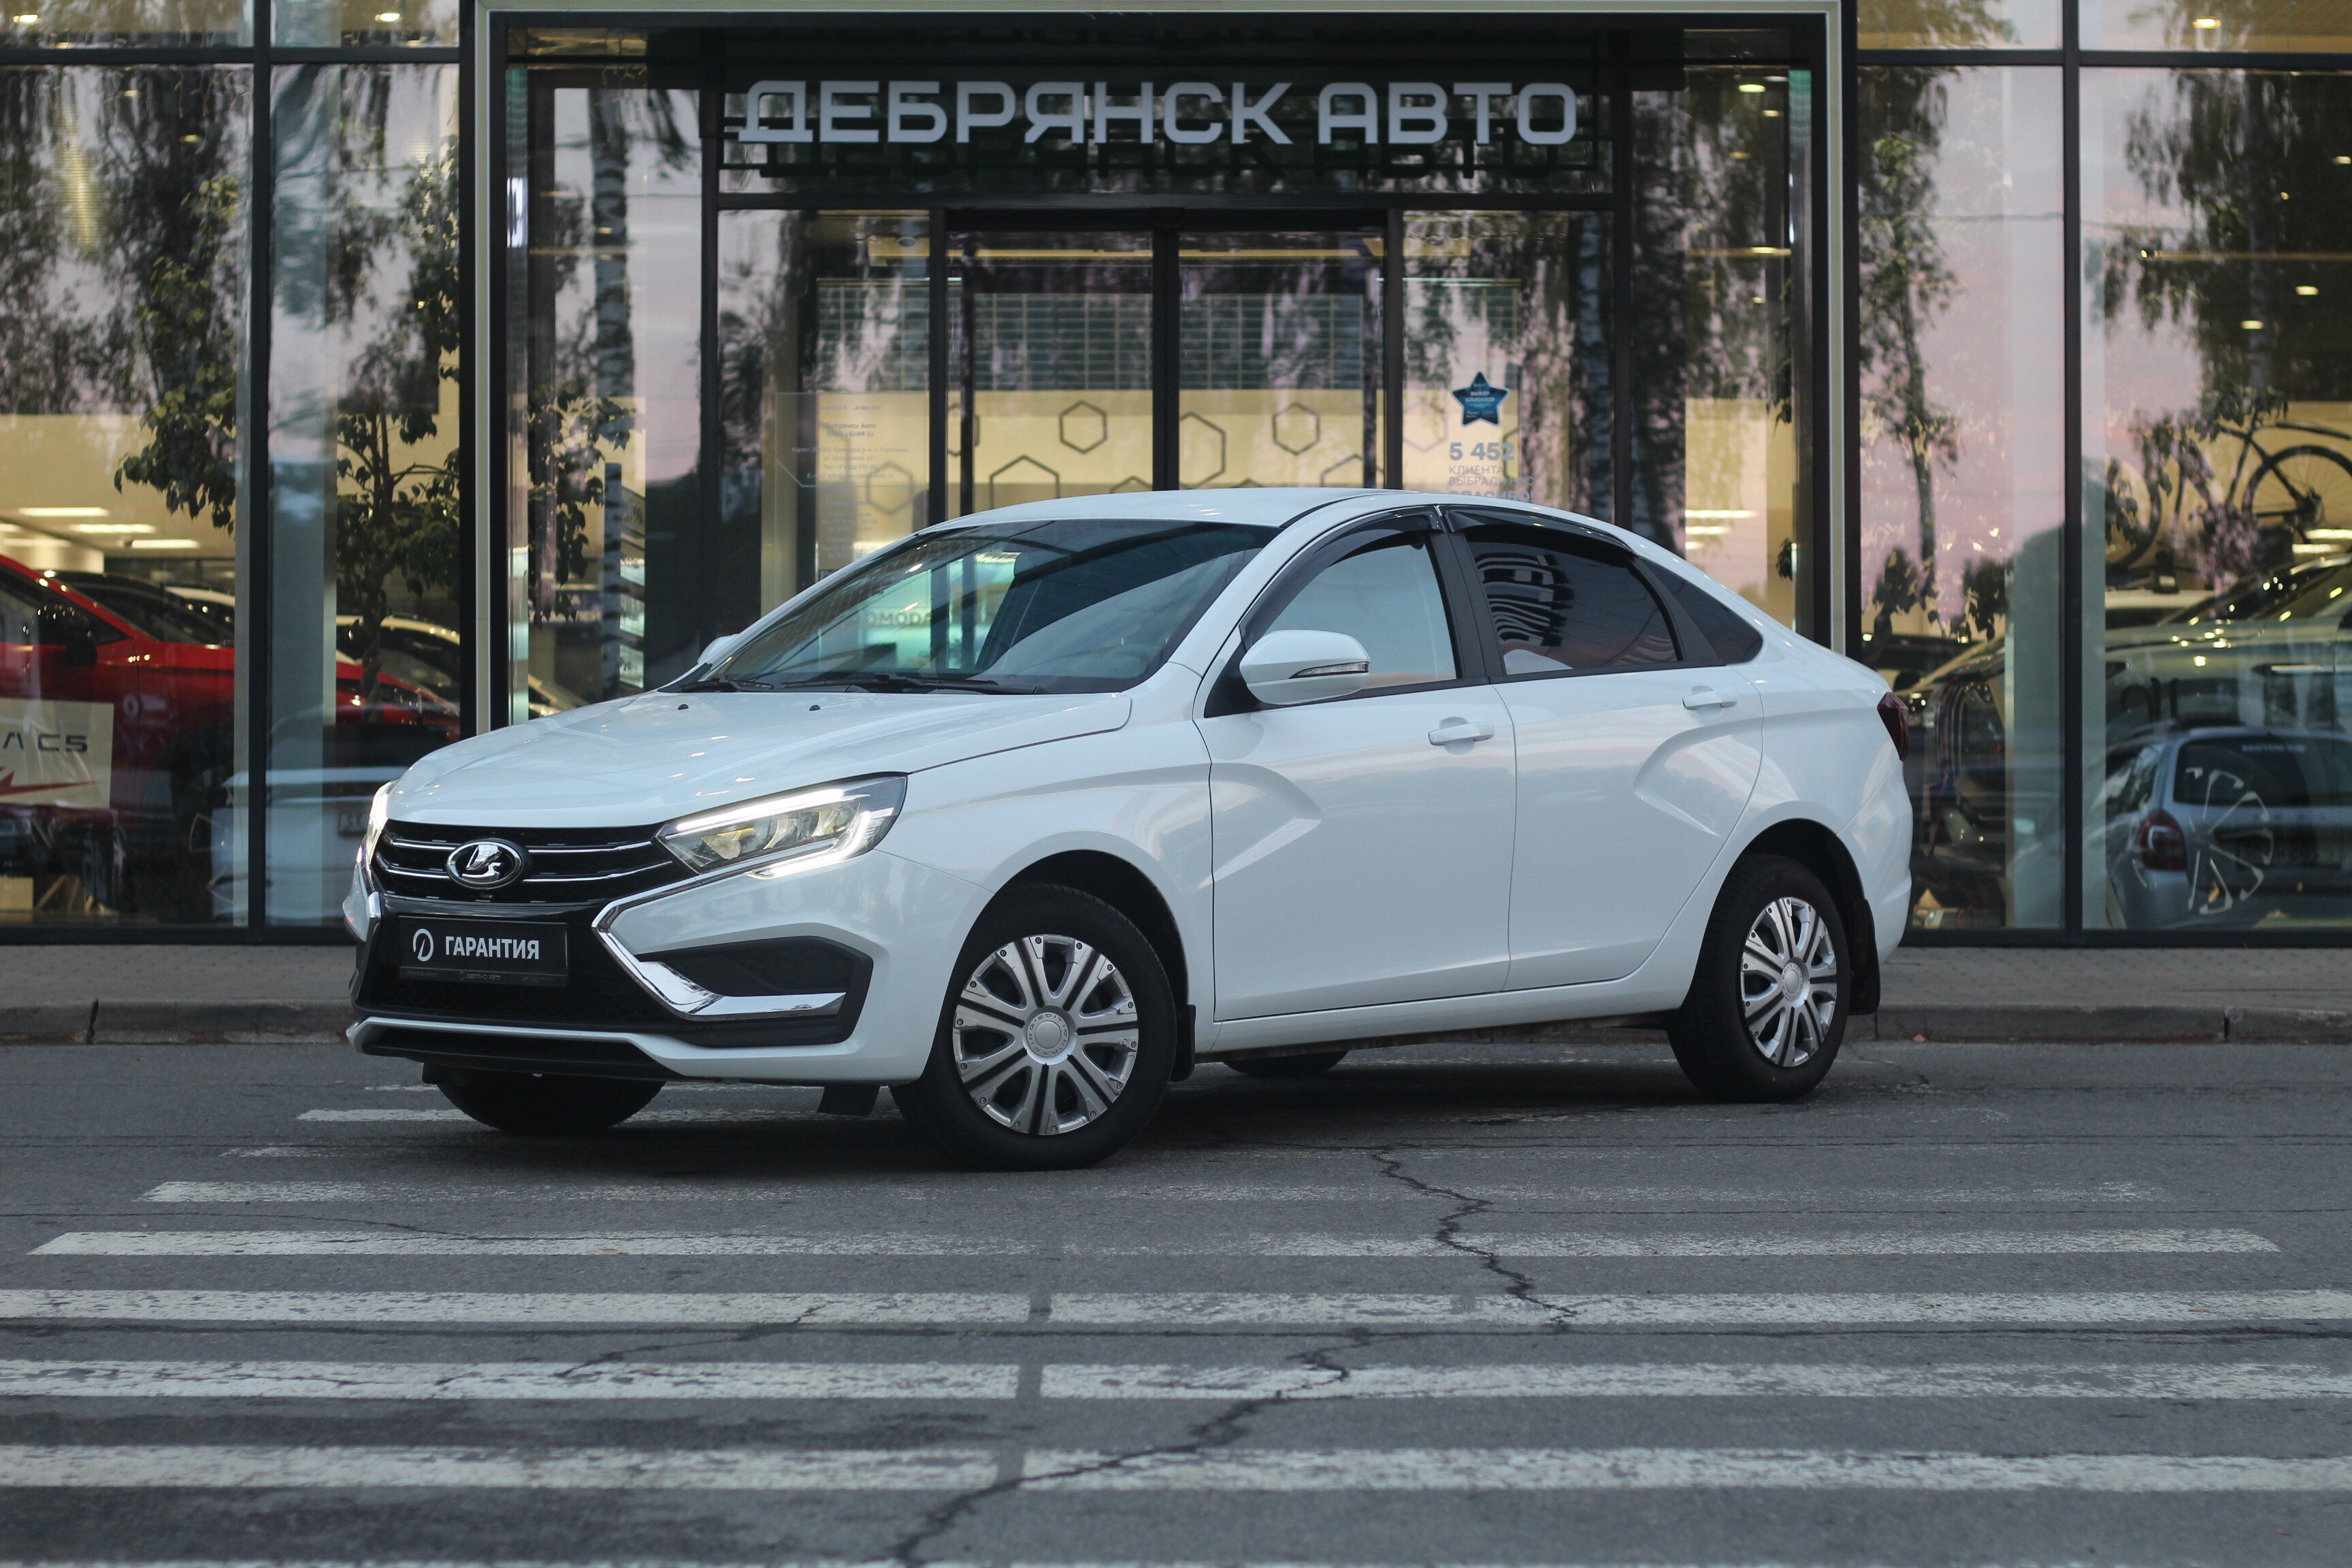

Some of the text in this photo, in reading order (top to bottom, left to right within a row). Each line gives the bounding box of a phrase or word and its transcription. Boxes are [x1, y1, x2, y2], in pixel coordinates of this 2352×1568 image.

[738, 81, 1578, 146] ДЕБРЯНСК АВТО
[1449, 442, 1515, 461] 5 452
[1449, 465, 1504, 475] КЛИЕНТА
[1449, 476, 1506, 486] ВЫБРАЛИ
[445, 935, 540, 960] ГАРАНТИЯ
